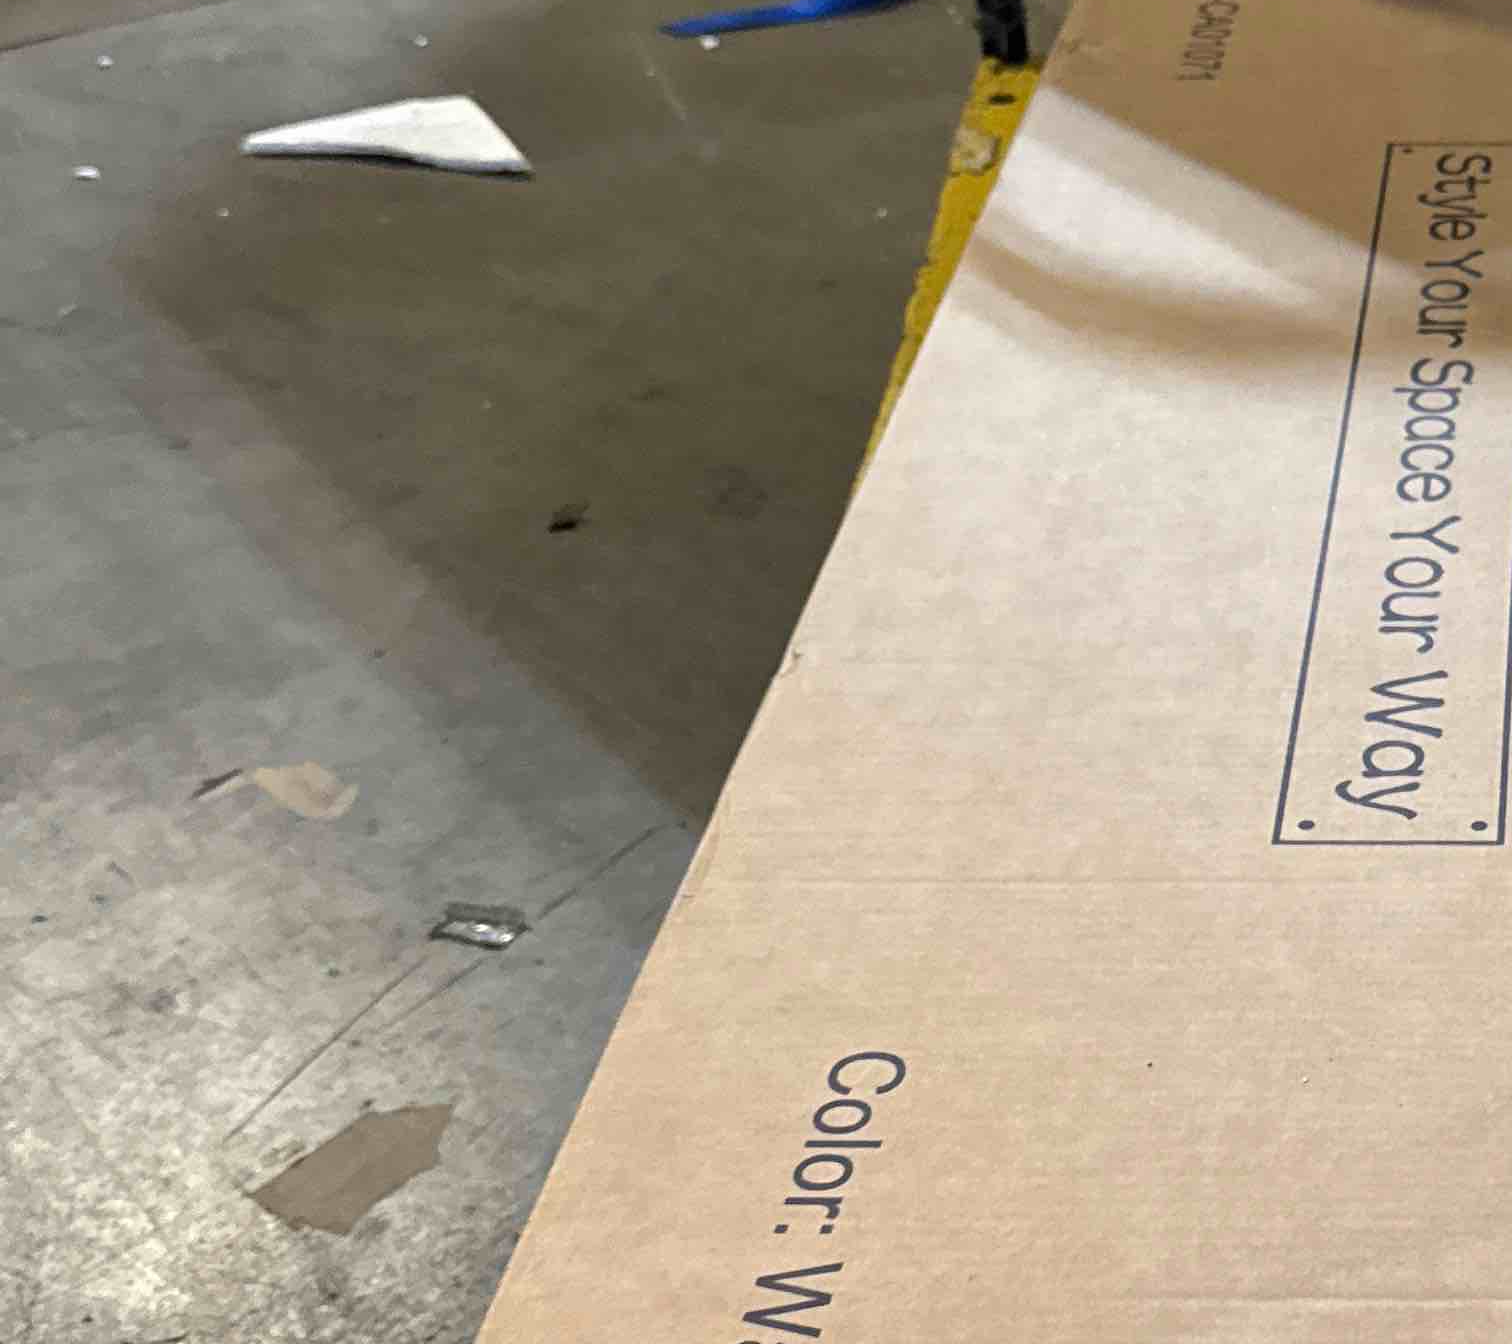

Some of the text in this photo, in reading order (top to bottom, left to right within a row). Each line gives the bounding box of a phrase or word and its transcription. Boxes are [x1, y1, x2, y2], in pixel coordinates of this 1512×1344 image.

[1334, 152, 1493, 821] Style Your Space Your Way
[773, 1050, 906, 1236] Color:
